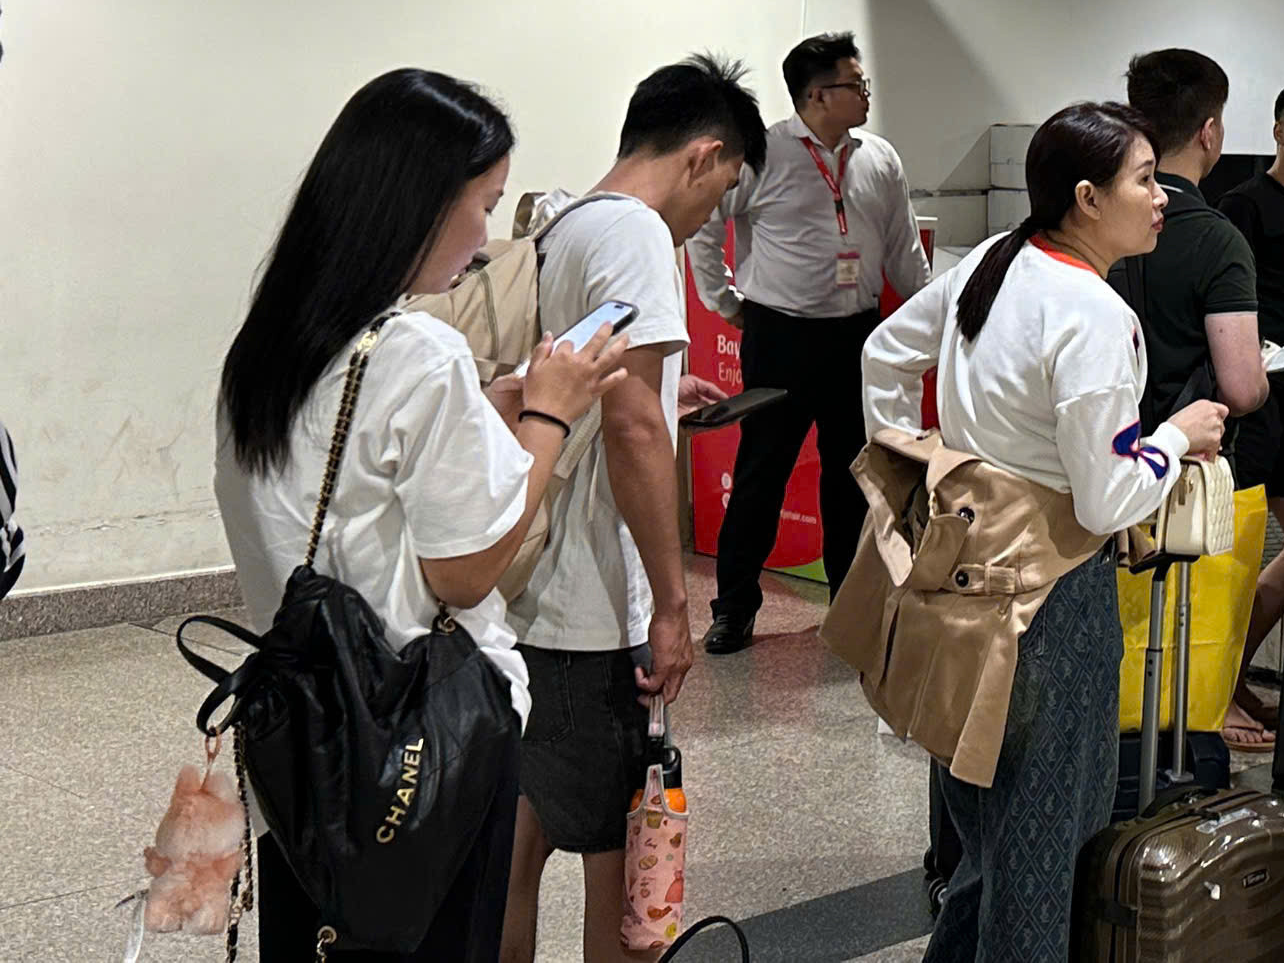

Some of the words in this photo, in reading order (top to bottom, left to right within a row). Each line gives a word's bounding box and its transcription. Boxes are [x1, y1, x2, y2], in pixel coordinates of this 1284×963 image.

[717, 334, 741, 360] Bay
[718, 361, 743, 387] Enjo
[376, 737, 424, 844] CHANEL
